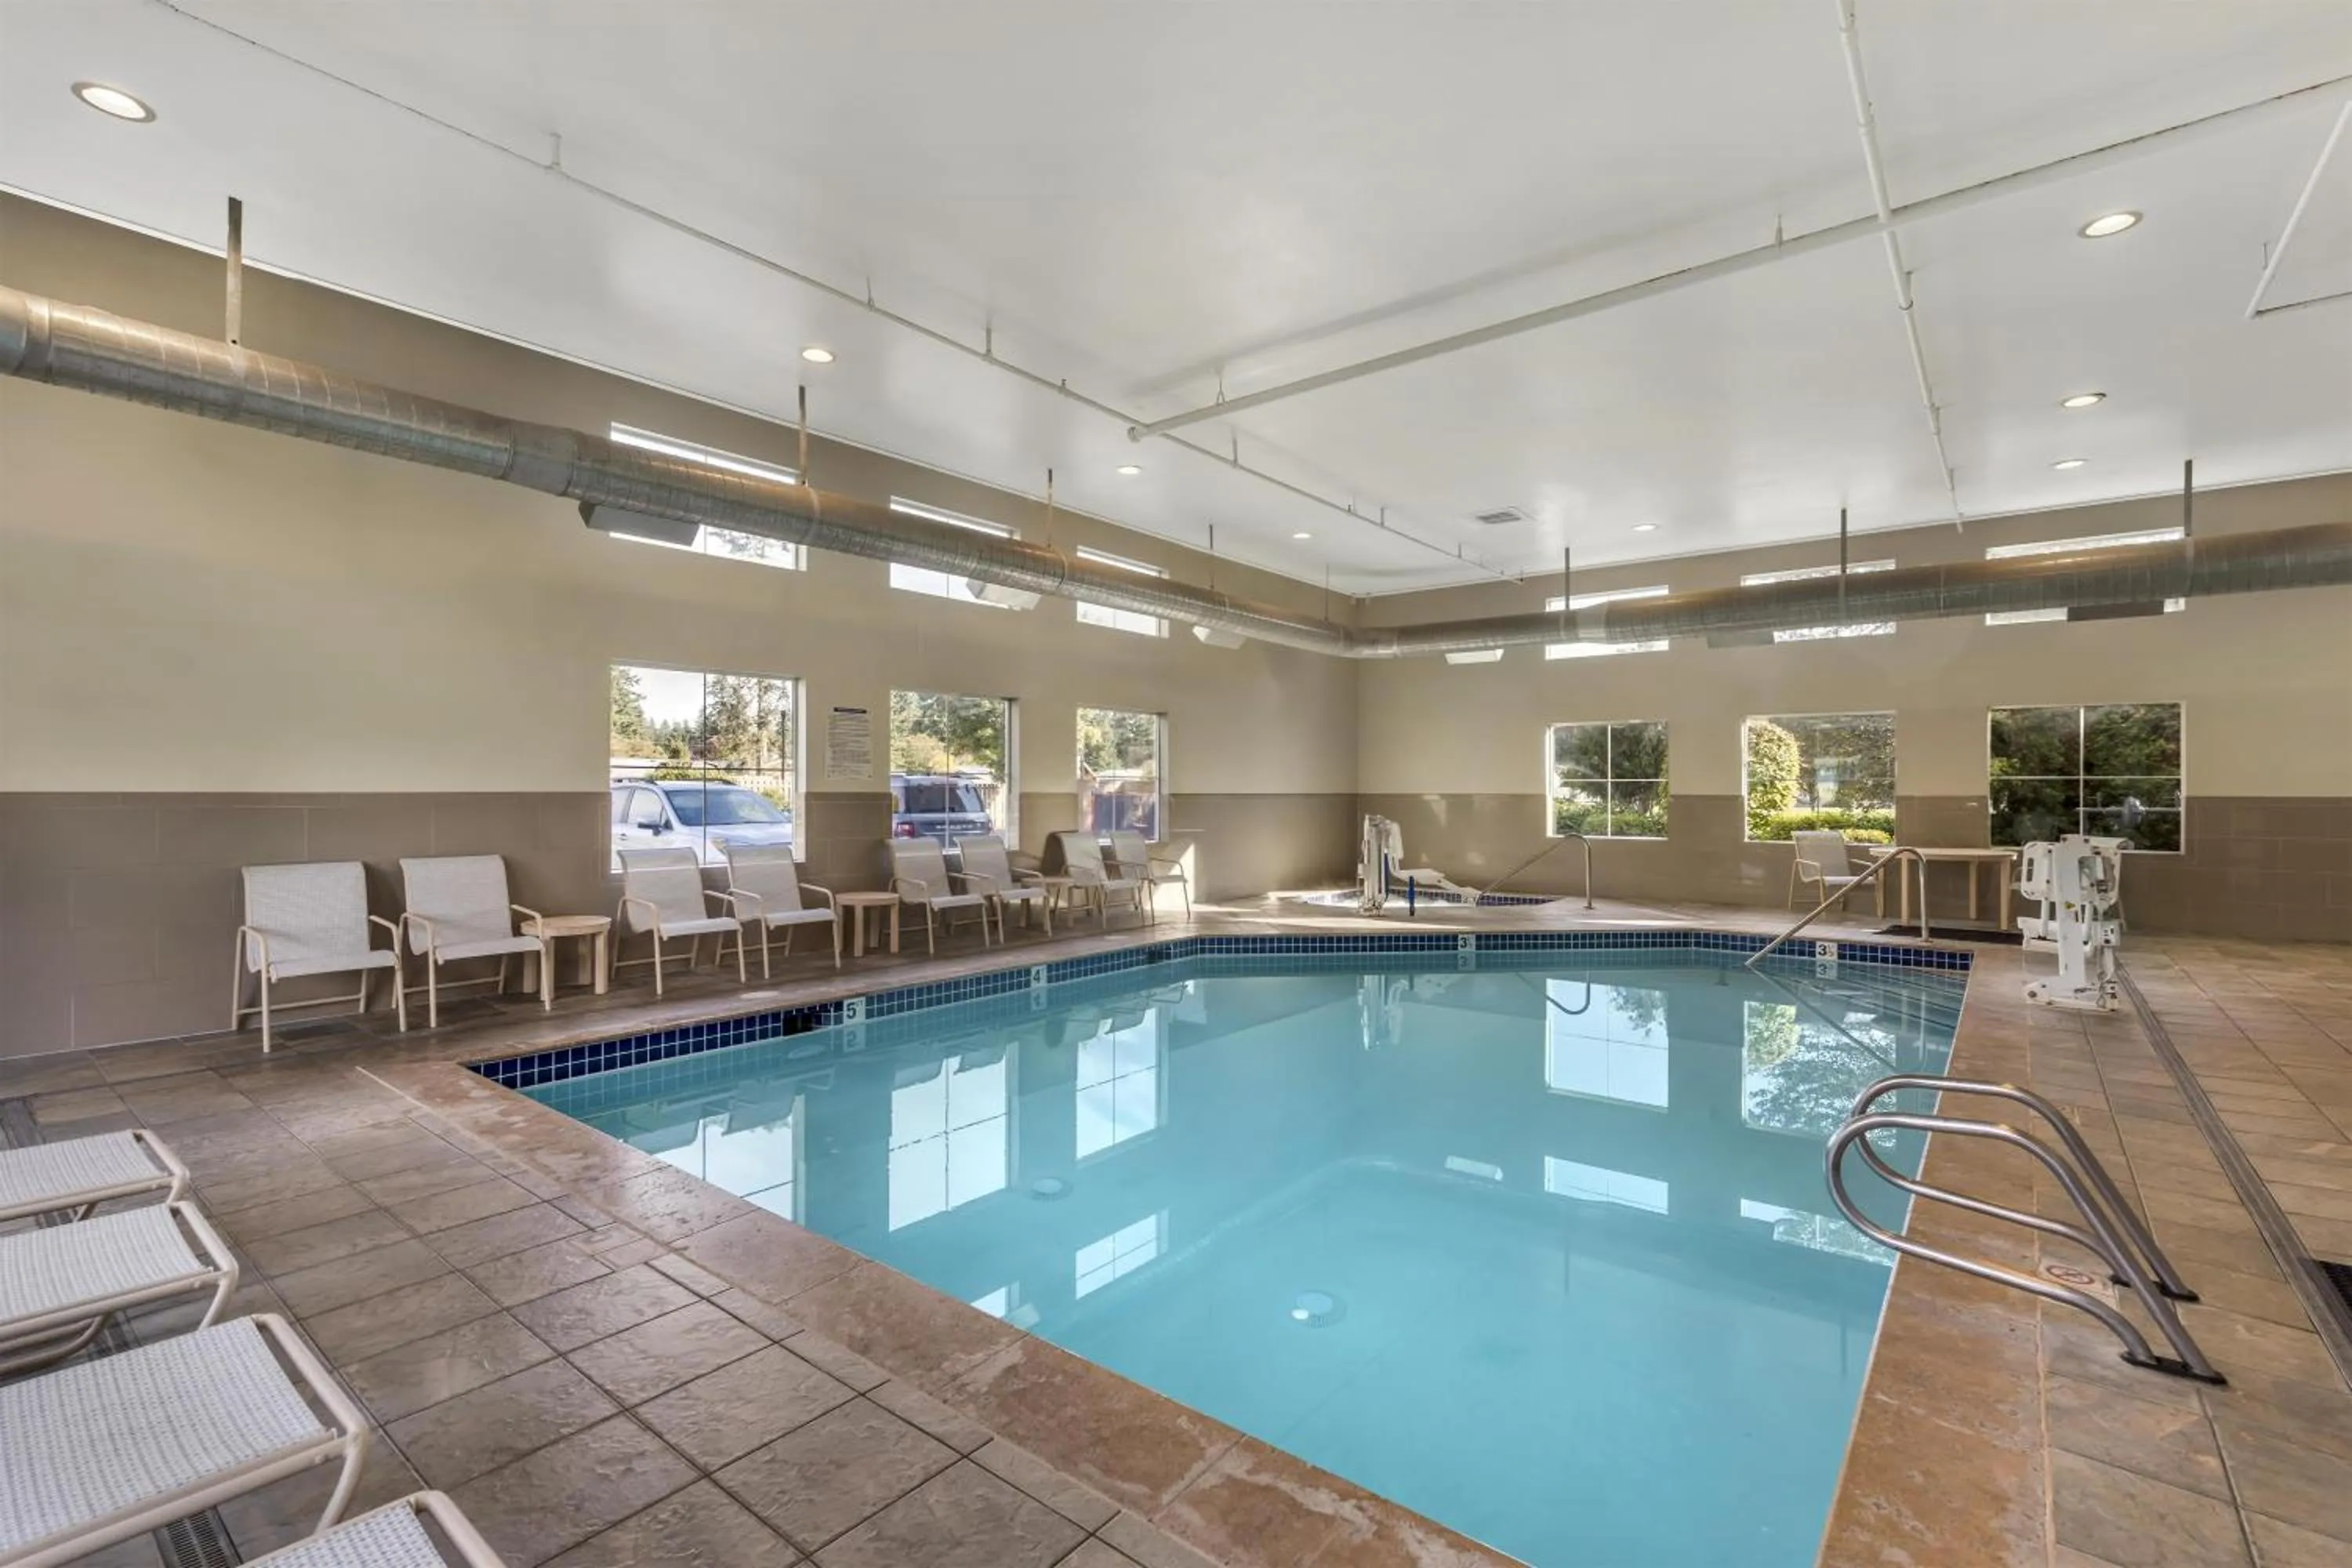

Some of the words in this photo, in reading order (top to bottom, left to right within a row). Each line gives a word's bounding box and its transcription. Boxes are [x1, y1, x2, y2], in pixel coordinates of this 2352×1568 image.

[1460, 937, 1467, 948] 3
[1818, 944, 1827, 956] 3
[847, 1002, 856, 1019] 5
